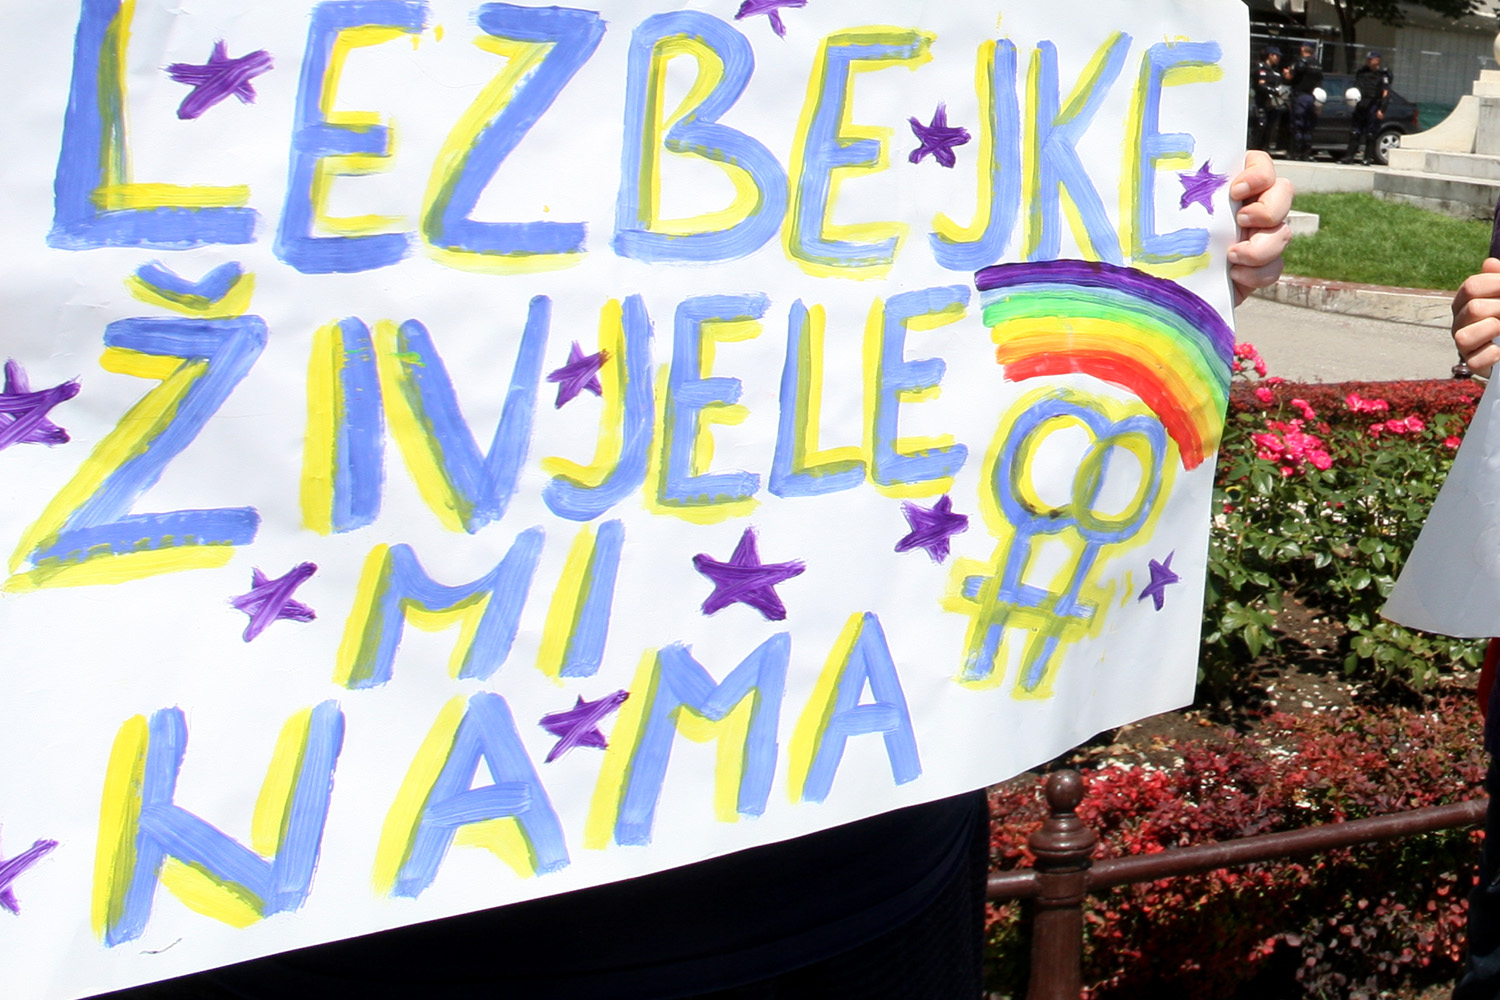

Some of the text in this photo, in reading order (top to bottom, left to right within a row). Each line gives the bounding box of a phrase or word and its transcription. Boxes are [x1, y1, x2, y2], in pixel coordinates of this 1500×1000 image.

[8, 260, 976, 592] ŽIVJELE
[335, 519, 626, 690] MI
[90, 610, 923, 947] NAMA
